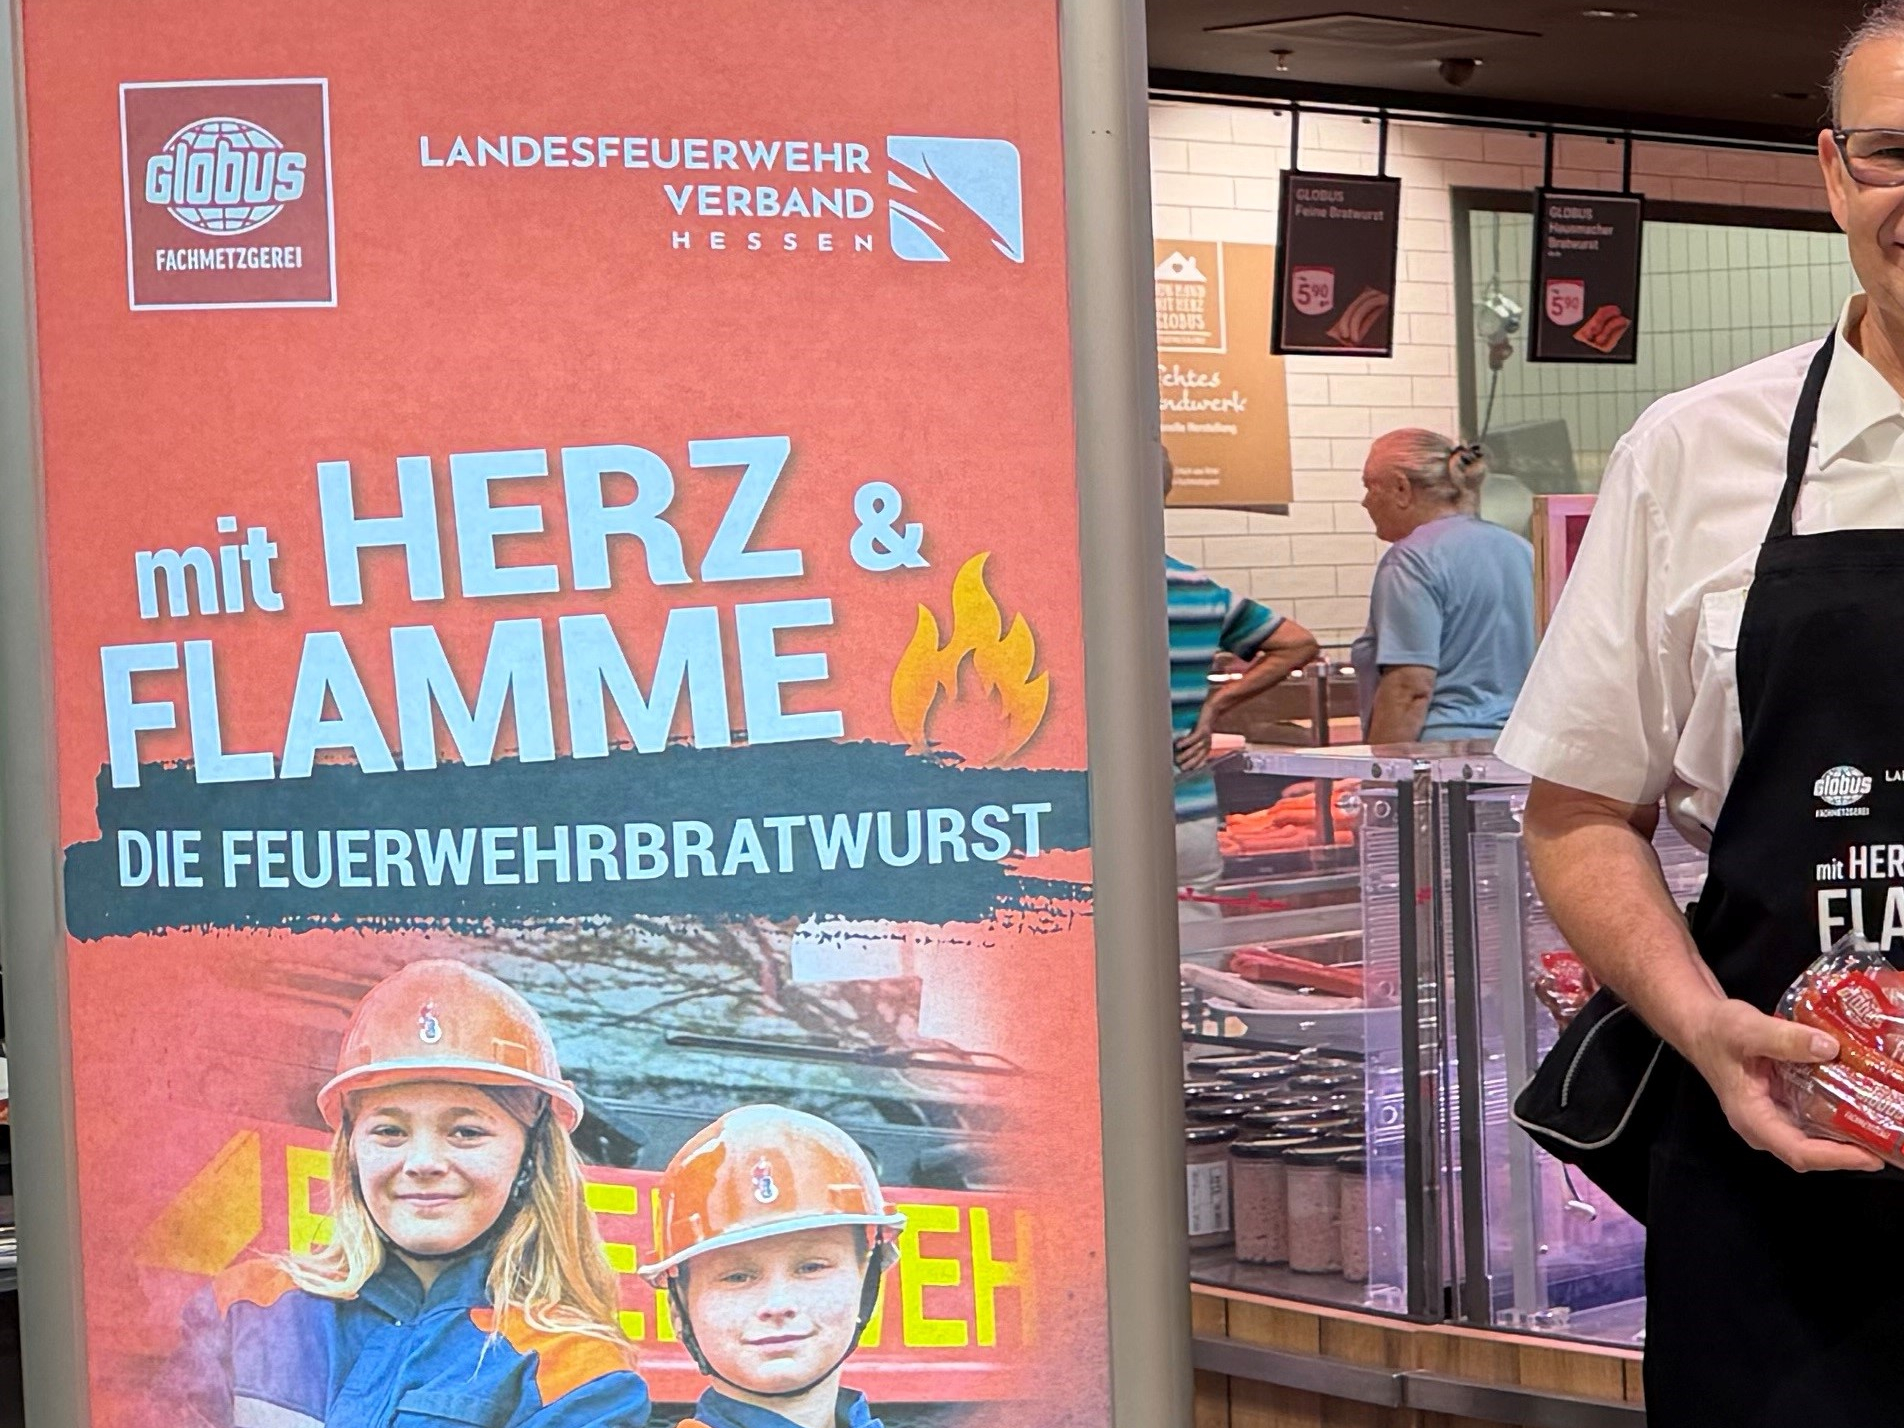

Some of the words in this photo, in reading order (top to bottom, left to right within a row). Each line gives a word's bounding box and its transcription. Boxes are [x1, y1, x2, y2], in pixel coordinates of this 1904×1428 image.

[420, 135, 872, 173] LANDESFEUERWEHR
[665, 186, 874, 219] VERBAND
[1296, 189, 1343, 202] GLOBUS
[672, 230, 874, 252] HESSEN
[155, 247, 303, 273] FACHMETZGEREI
[134, 516, 283, 619] mit
[315, 436, 803, 607] HERZ
[849, 481, 928, 571] &
[100, 598, 844, 790] FLAMME
[117, 827, 202, 889] DIE
[222, 802, 1053, 889] FEUERWEHRBRATWURST
[1816, 858, 1843, 881] mit
